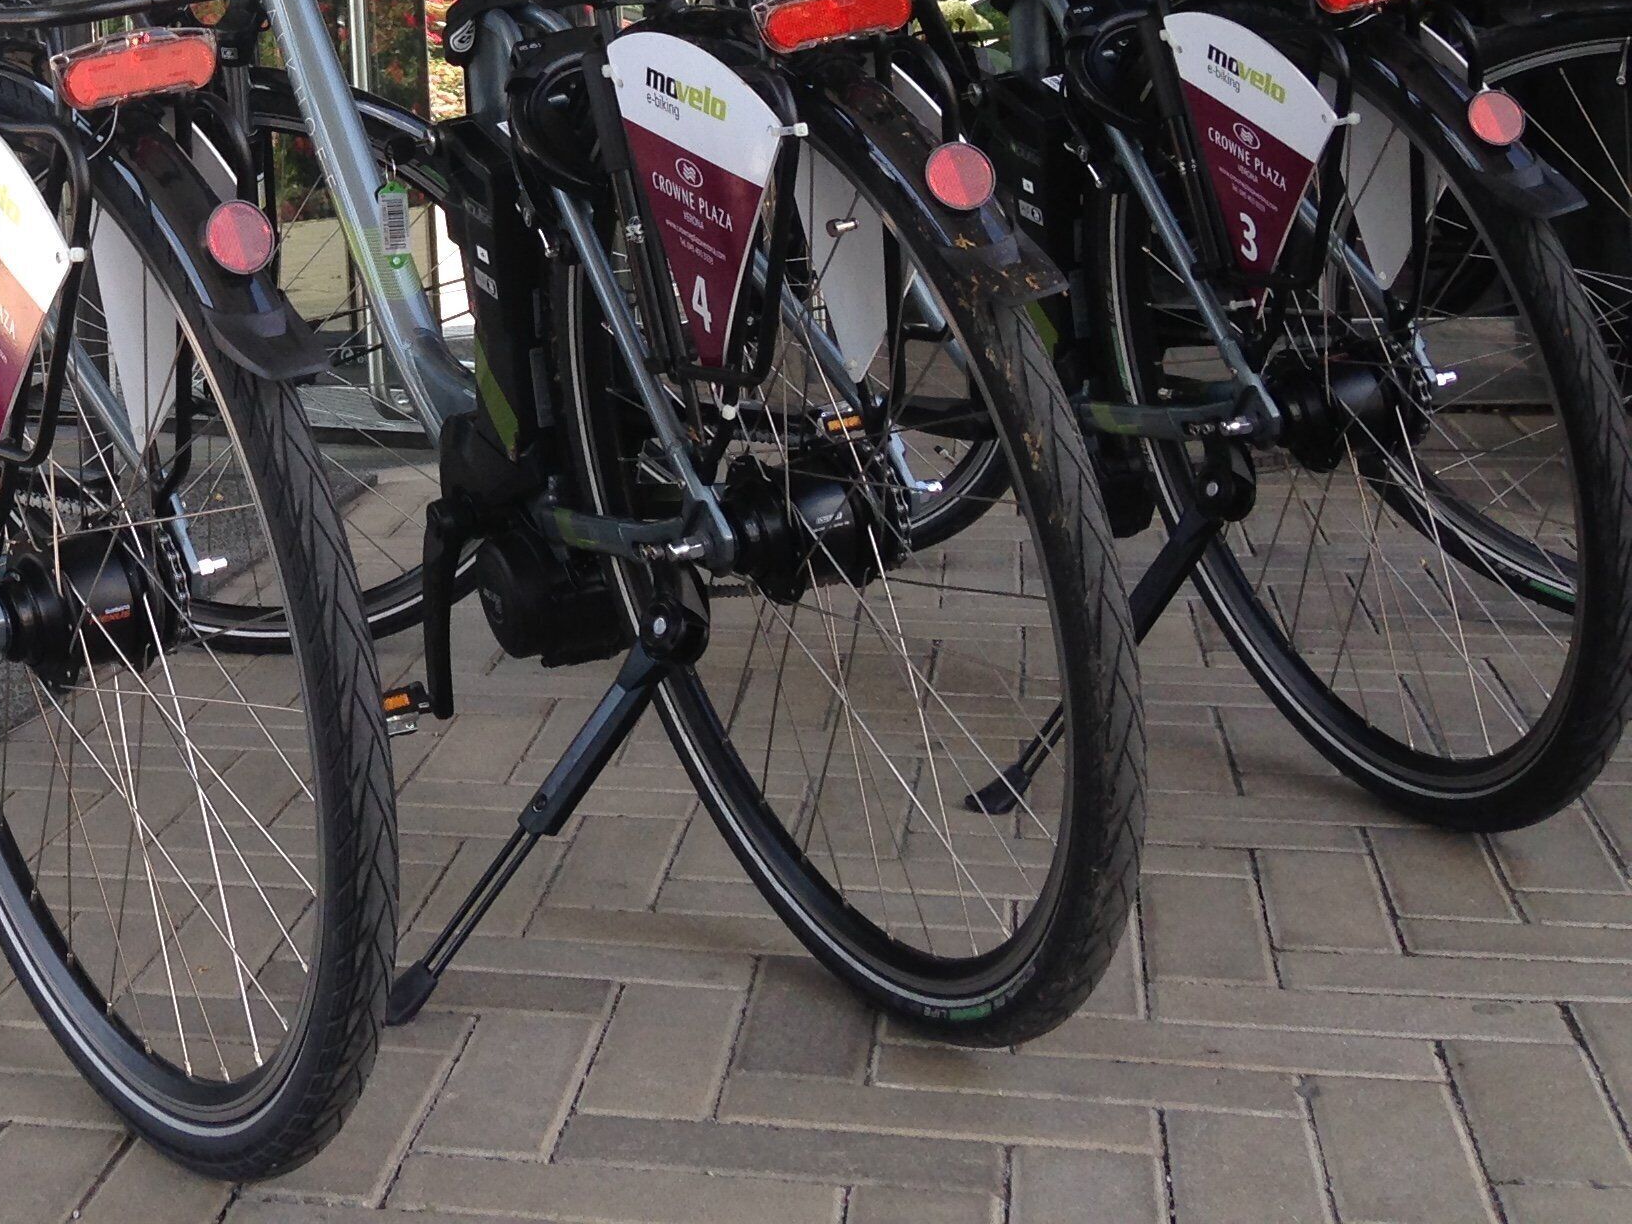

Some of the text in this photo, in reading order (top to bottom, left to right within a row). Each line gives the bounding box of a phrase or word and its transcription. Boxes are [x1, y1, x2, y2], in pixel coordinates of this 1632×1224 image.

[645, 67, 727, 122] movelo
[1207, 44, 1287, 105] movelo
[1207, 64, 1241, 94] e-biking
[646, 92, 680, 121] e-biking
[1207, 126, 1251, 166] CROWNE
[1254, 157, 1287, 192] PLAZA
[652, 171, 733, 232] CROWNE PLAZA
[1239, 211, 1258, 262] 3
[691, 274, 712, 334] 4
